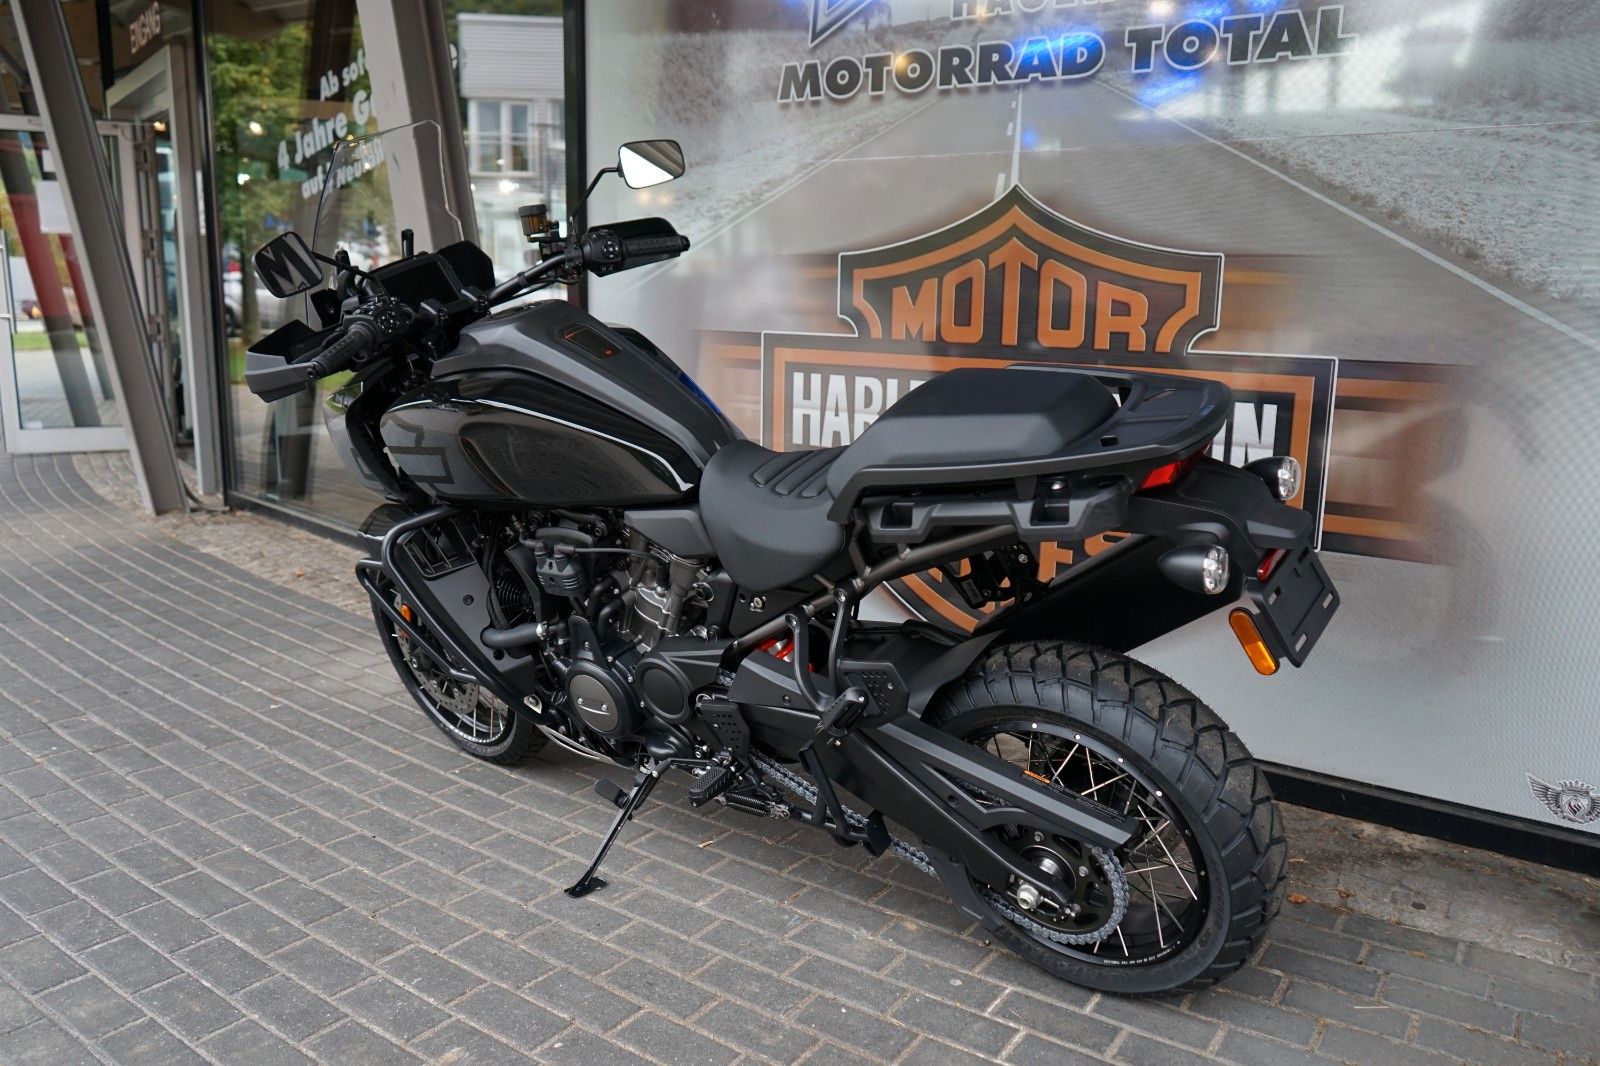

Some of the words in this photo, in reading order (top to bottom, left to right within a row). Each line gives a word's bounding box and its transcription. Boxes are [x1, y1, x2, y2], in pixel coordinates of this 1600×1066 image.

[129, 0, 161, 54] EINGANG
[777, 30, 1106, 104] MOTORRAD
[1124, 4, 1361, 73] TOTAL
[319, 69, 340, 101] Ab
[277, 139, 290, 170] 4
[294, 111, 348, 165] Jahre
[891, 236, 1149, 352] MOTOR
